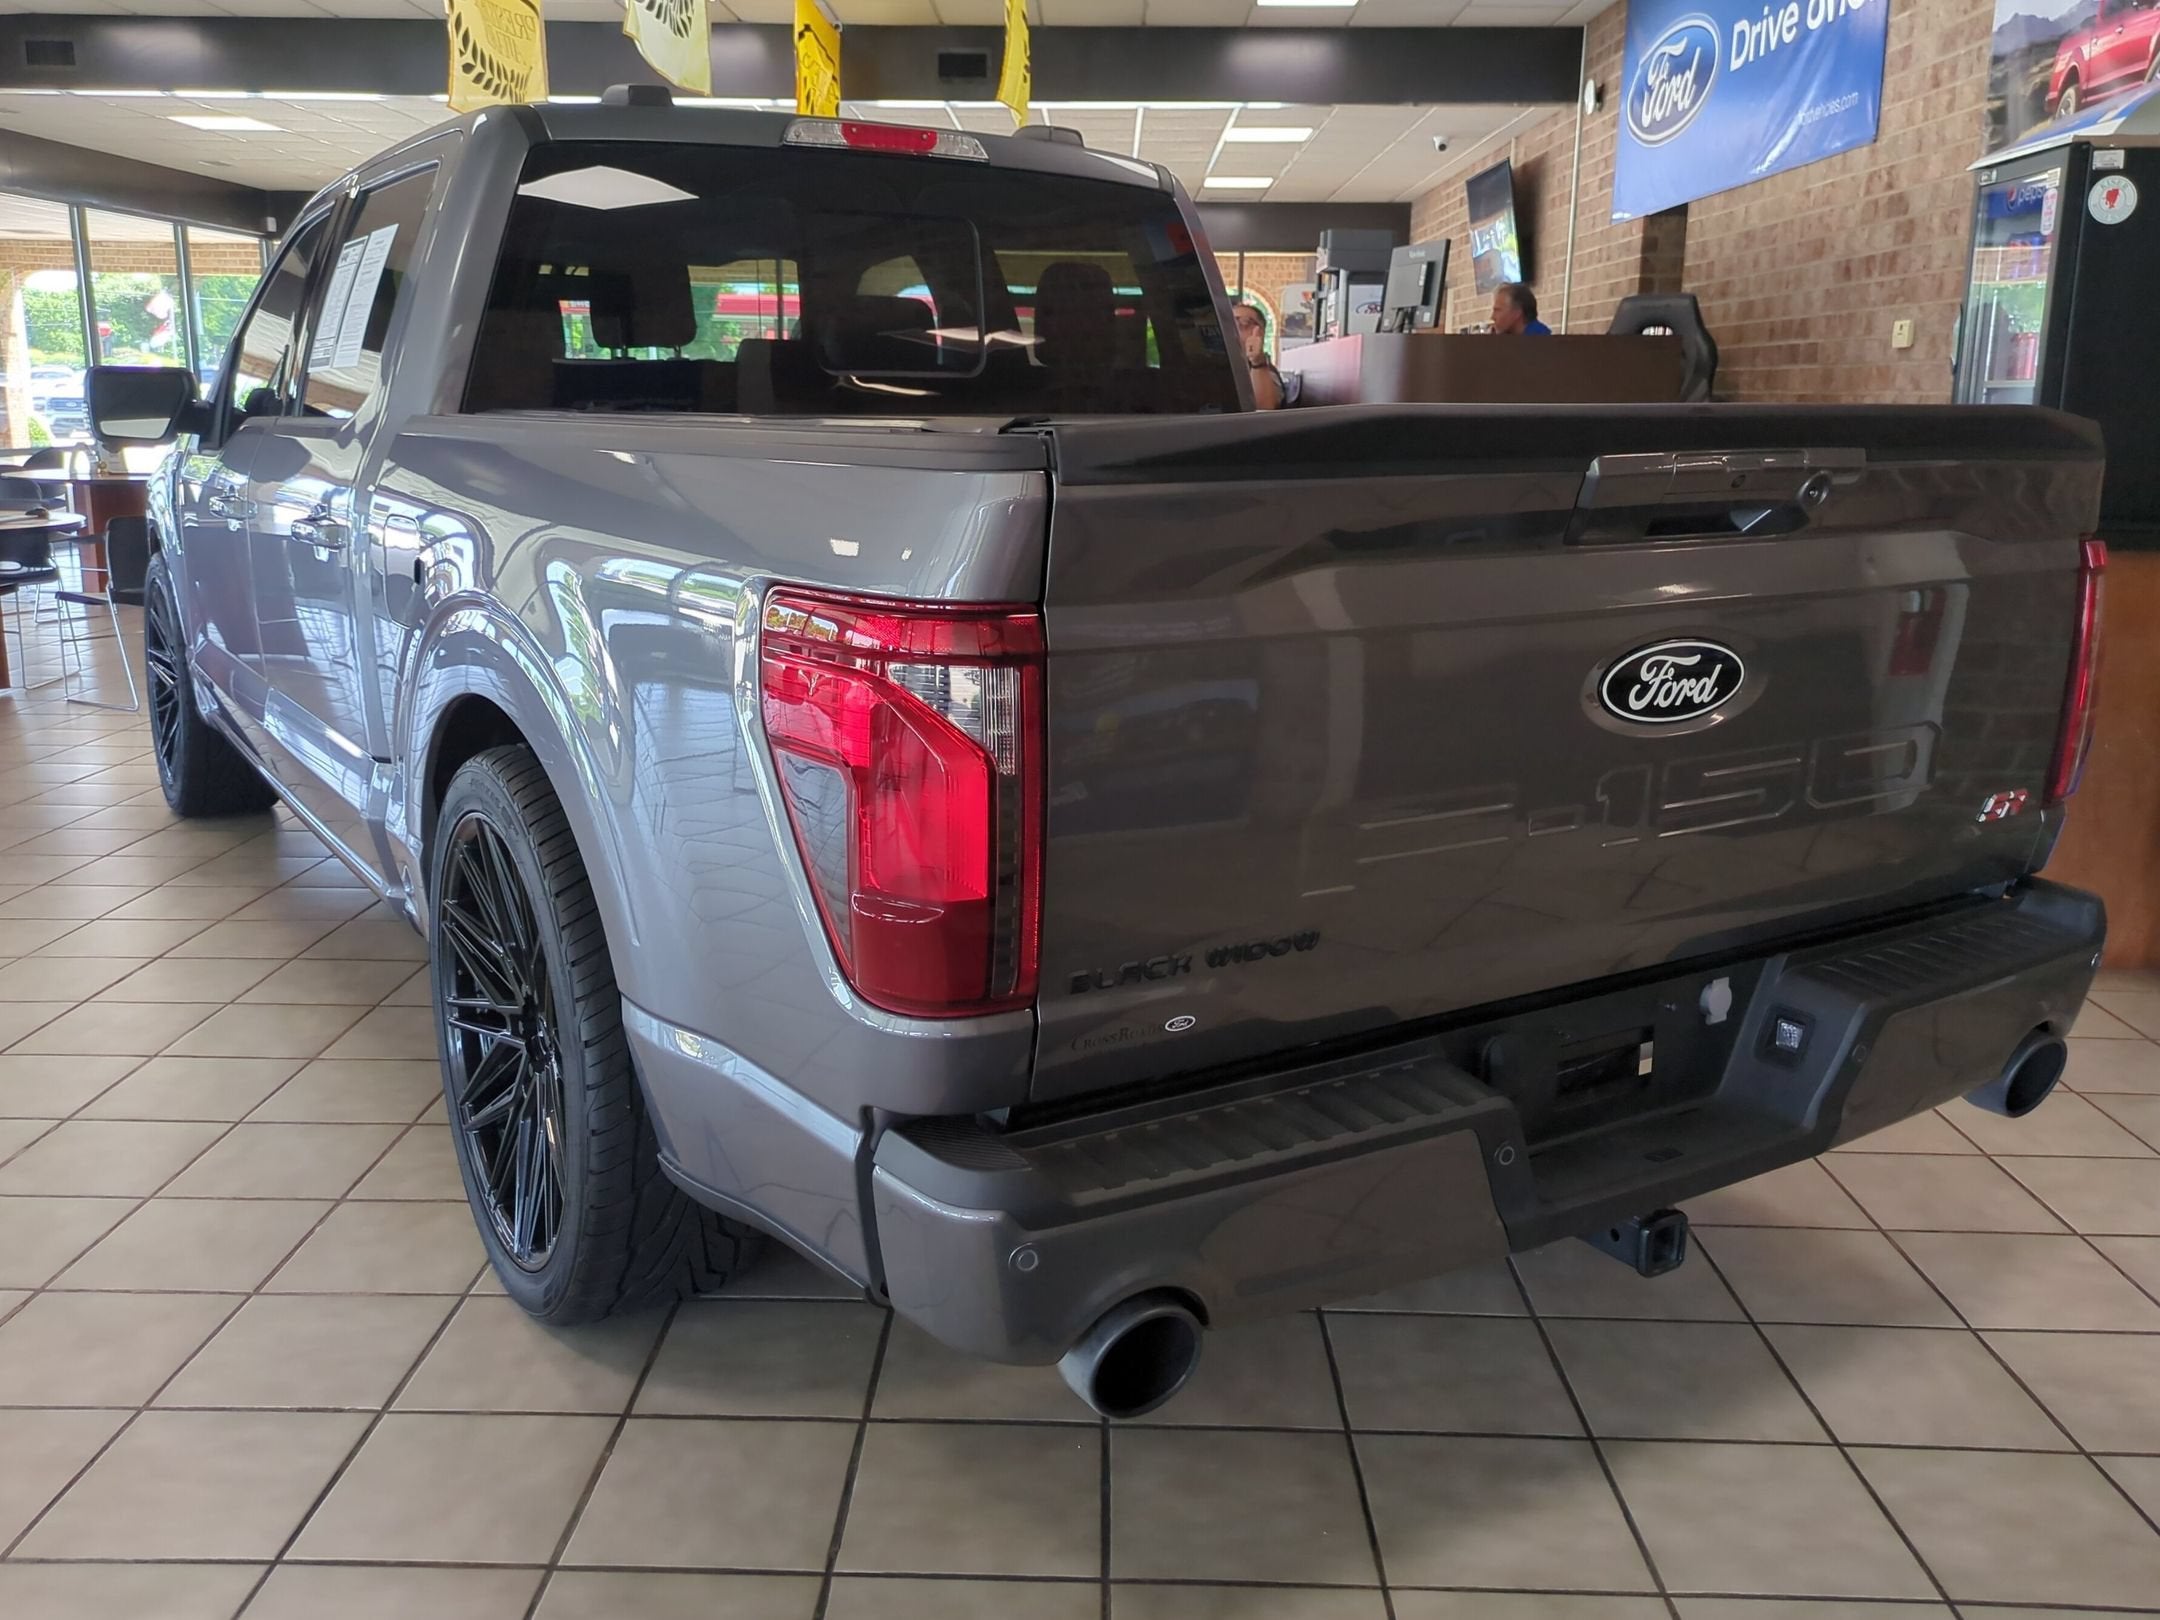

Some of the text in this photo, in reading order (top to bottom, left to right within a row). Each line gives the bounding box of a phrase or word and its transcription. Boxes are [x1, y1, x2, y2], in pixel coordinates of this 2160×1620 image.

[1729, 2, 1799, 72] Drive
[1641, 36, 1702, 128] Ford
[1628, 654, 1722, 711] Ford
[1068, 929, 1320, 995] BLACK WIDOW
